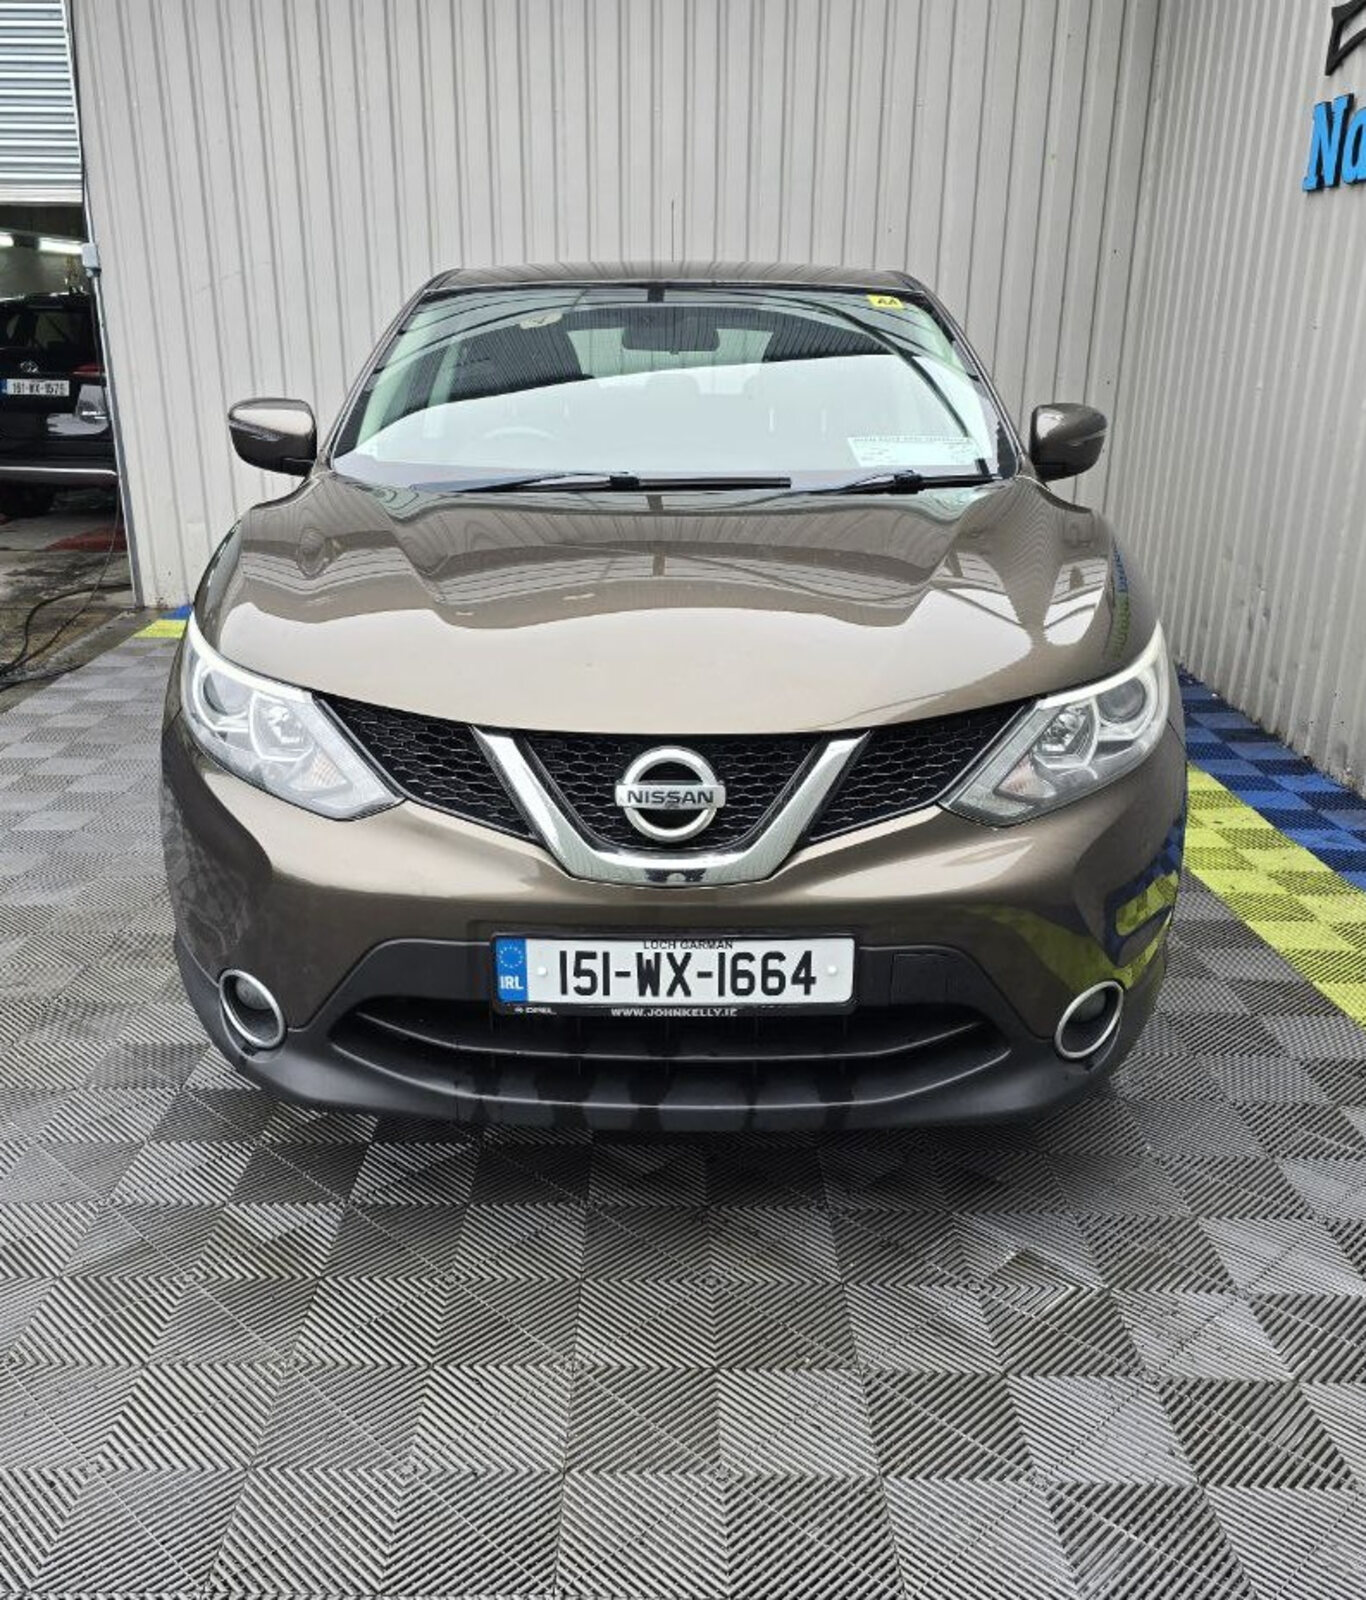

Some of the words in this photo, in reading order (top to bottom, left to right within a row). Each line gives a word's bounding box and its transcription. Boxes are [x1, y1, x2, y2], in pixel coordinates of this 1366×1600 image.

[627, 790, 714, 804] NISSAN
[643, 940, 676, 949] LOCH
[680, 940, 733, 949] GARMAN
[559, 950, 817, 997] 151-WX-1664
[500, 975, 524, 990] IRL
[610, 1007, 738, 1017] WWW.JOHNKELLY.IE
